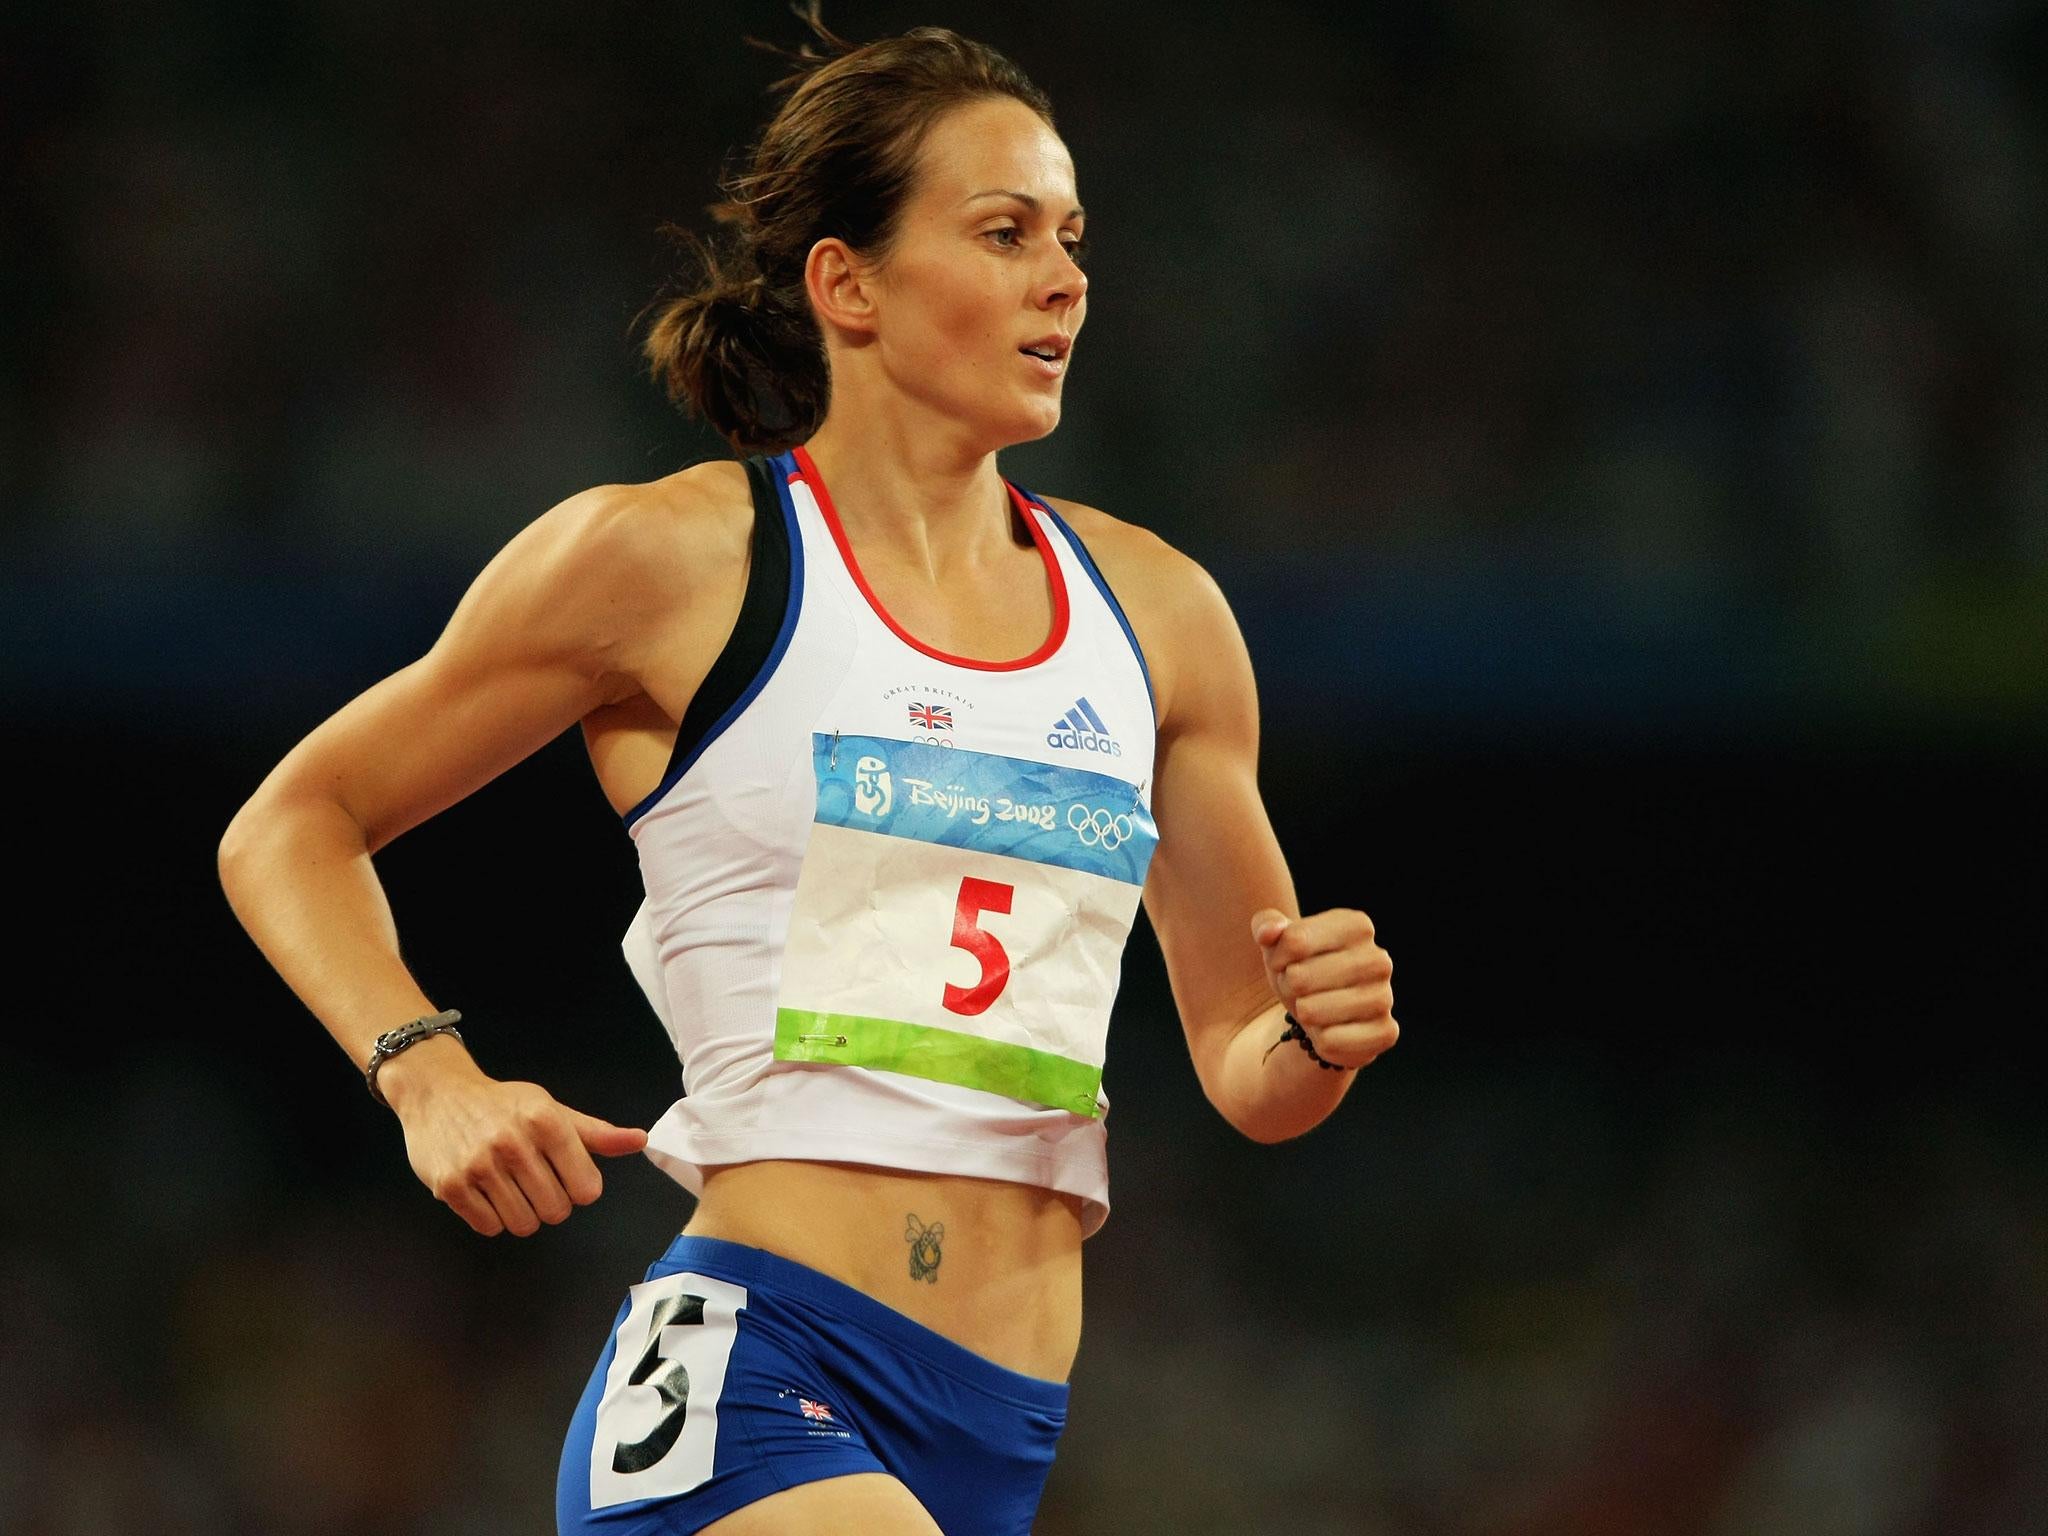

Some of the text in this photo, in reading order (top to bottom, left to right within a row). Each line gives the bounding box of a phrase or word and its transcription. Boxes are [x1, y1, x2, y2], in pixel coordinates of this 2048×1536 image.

[882, 684, 975, 710] GREAT BRITAIN
[1047, 729, 1121, 757] adidas
[902, 778, 1056, 830] Beijing 2008
[942, 876, 1014, 1017] 5
[611, 1293, 708, 1474] 5
